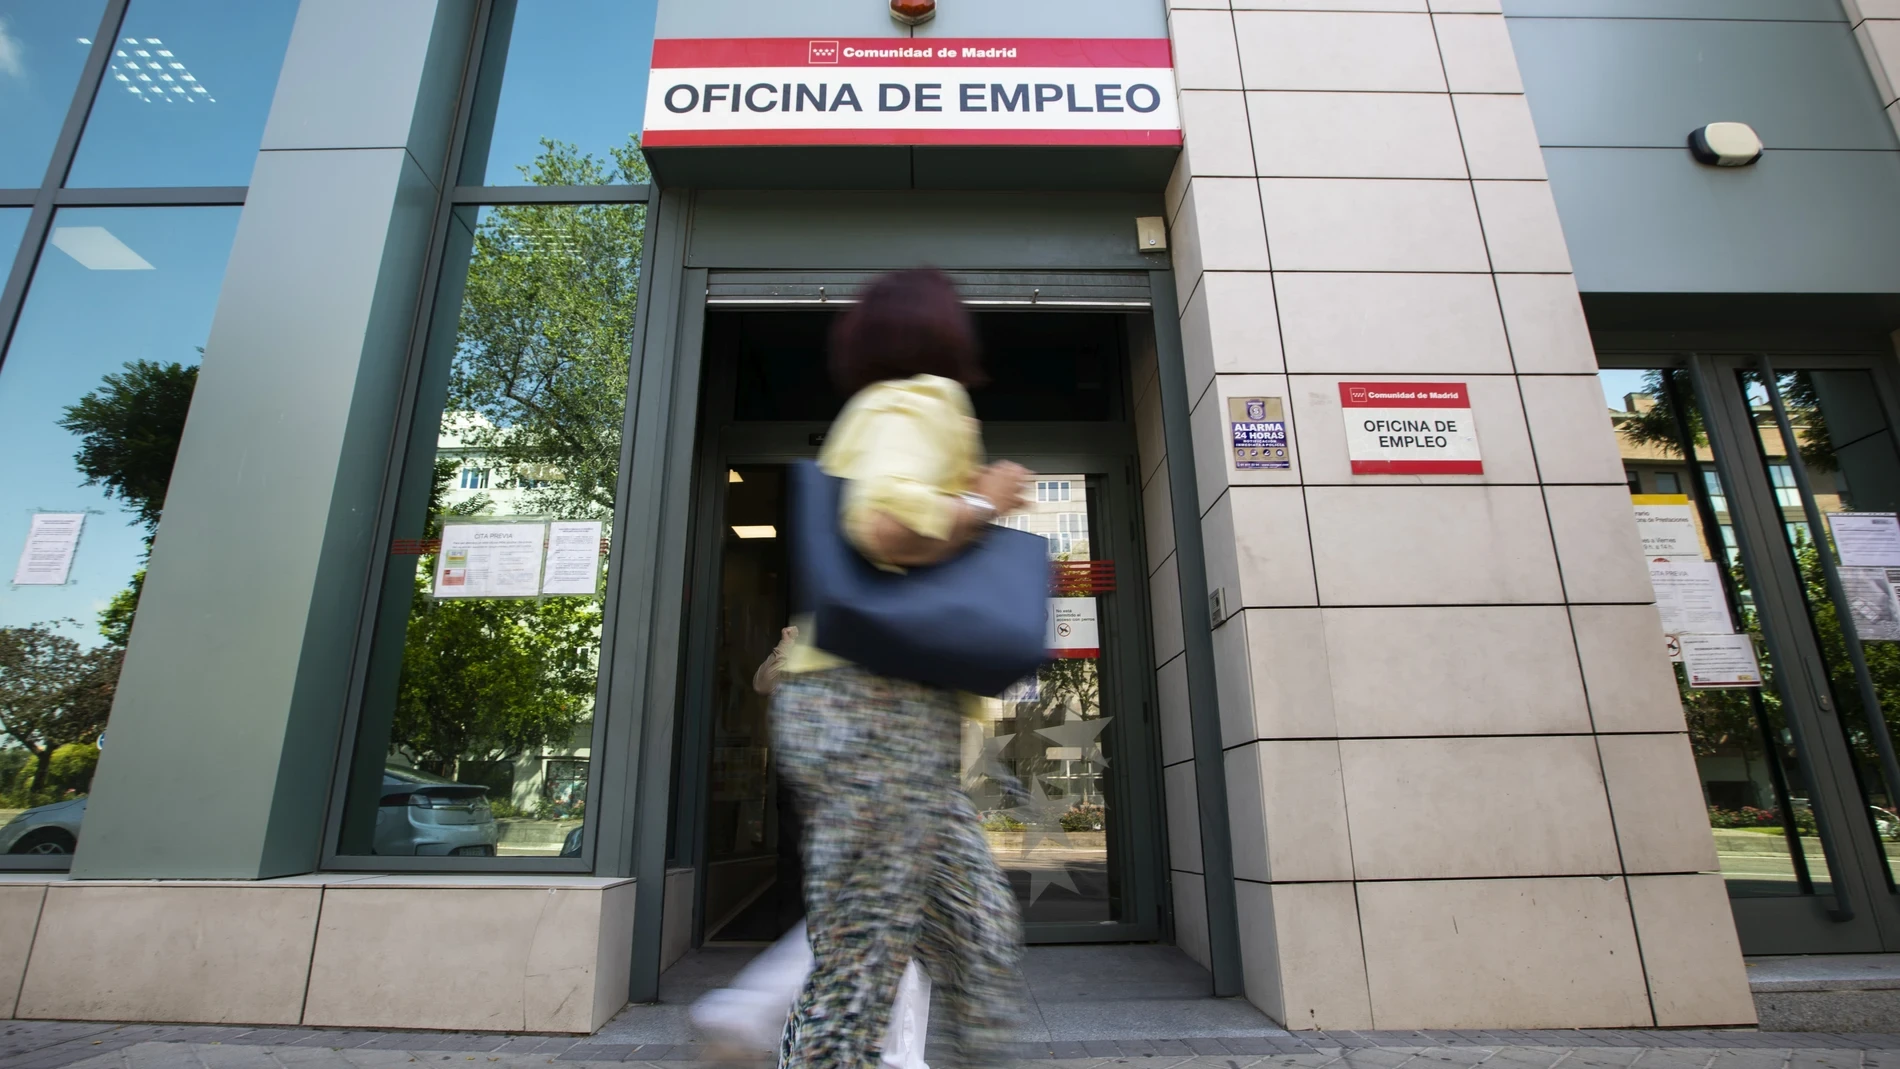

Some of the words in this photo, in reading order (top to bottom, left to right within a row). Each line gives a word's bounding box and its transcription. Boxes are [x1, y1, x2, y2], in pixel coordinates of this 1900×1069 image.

[843, 47, 933, 58] Comunidad
[937, 47, 957, 58] de
[962, 47, 1017, 58] Madrid
[664, 82, 864, 114] OFICINA
[878, 82, 943, 113] DE
[959, 82, 1162, 114] EMPLEO
[1368, 391, 1415, 400] Comunidad
[1417, 391, 1428, 400] de
[1430, 391, 1459, 400] Madrid
[1234, 423, 1283, 431] ALARMA
[1363, 420, 1431, 432] OFICINA
[1435, 420, 1458, 432] DE
[1379, 435, 1448, 448] EMPLEO
